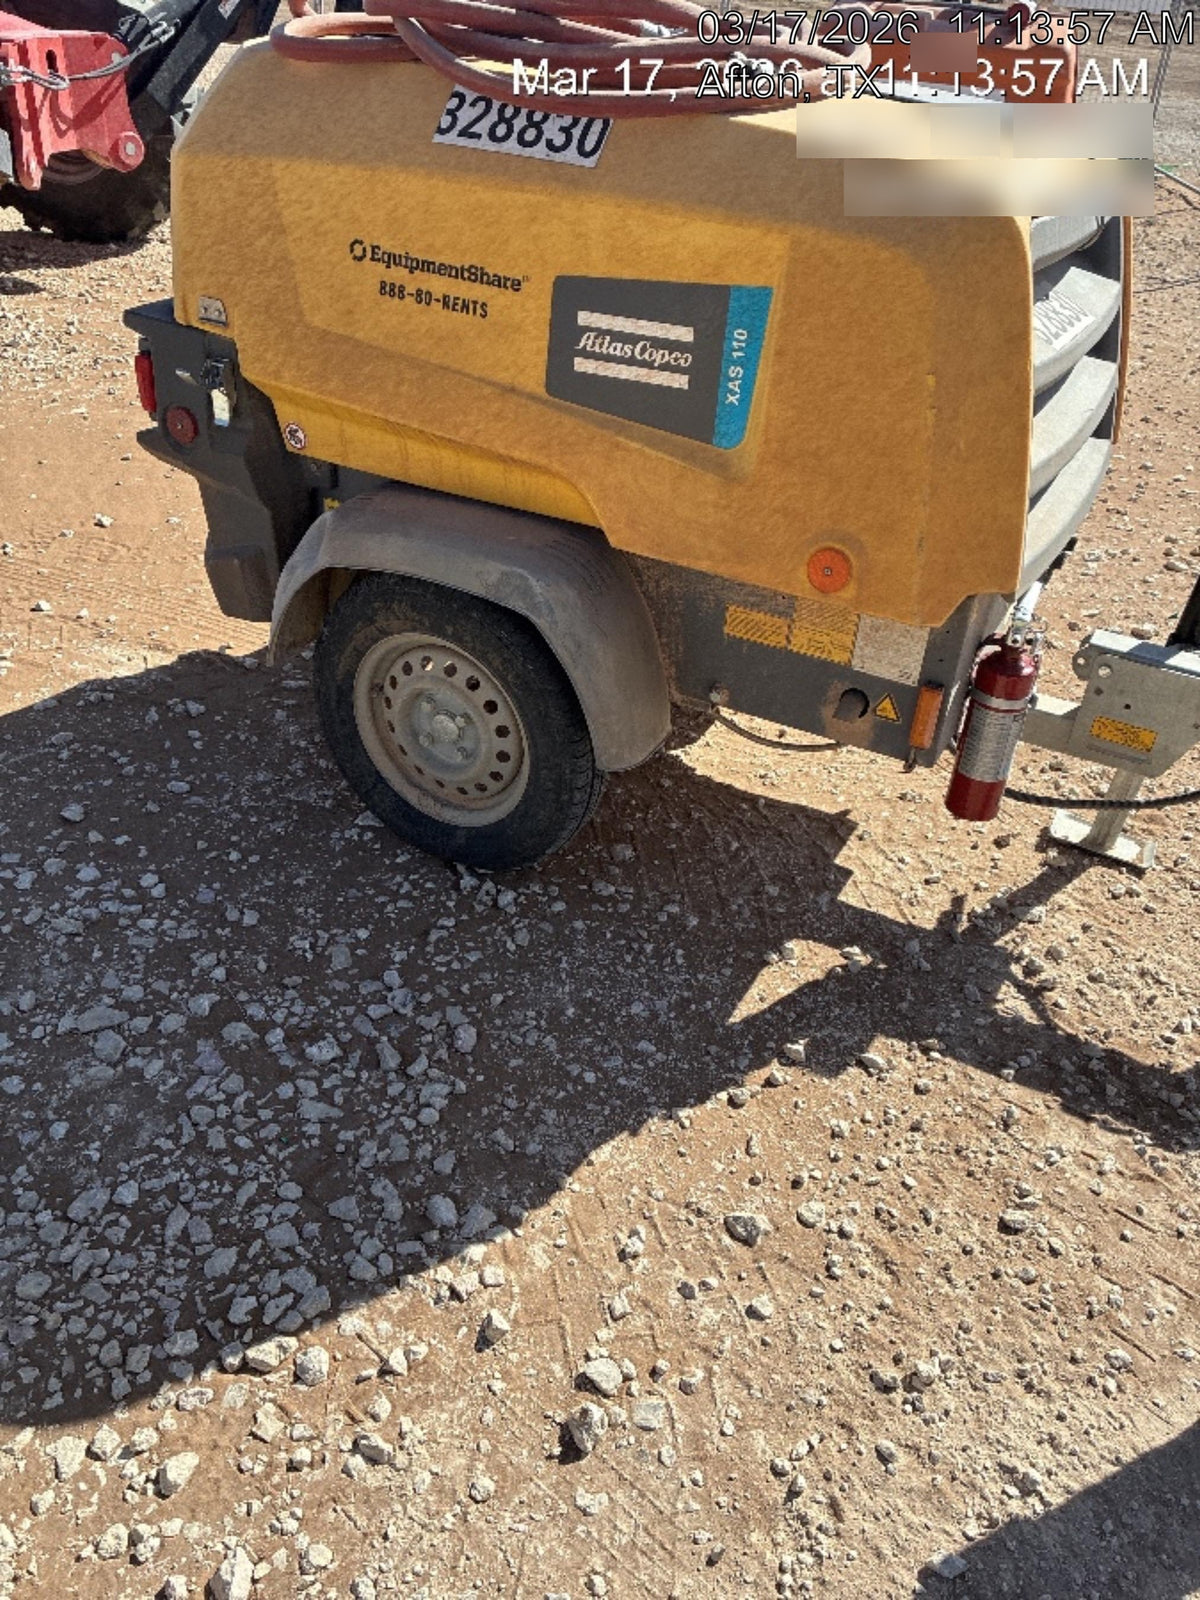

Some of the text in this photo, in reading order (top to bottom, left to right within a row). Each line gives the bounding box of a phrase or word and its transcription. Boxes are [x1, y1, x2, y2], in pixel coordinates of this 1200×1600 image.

[436, 91, 610, 158] 328830
[369, 244, 523, 292] EquipmentShare
[379, 280, 488, 319] 888-80-RENTS
[574, 331, 693, 368] Atlas Copco
[725, 328, 748, 406] XAS 110
